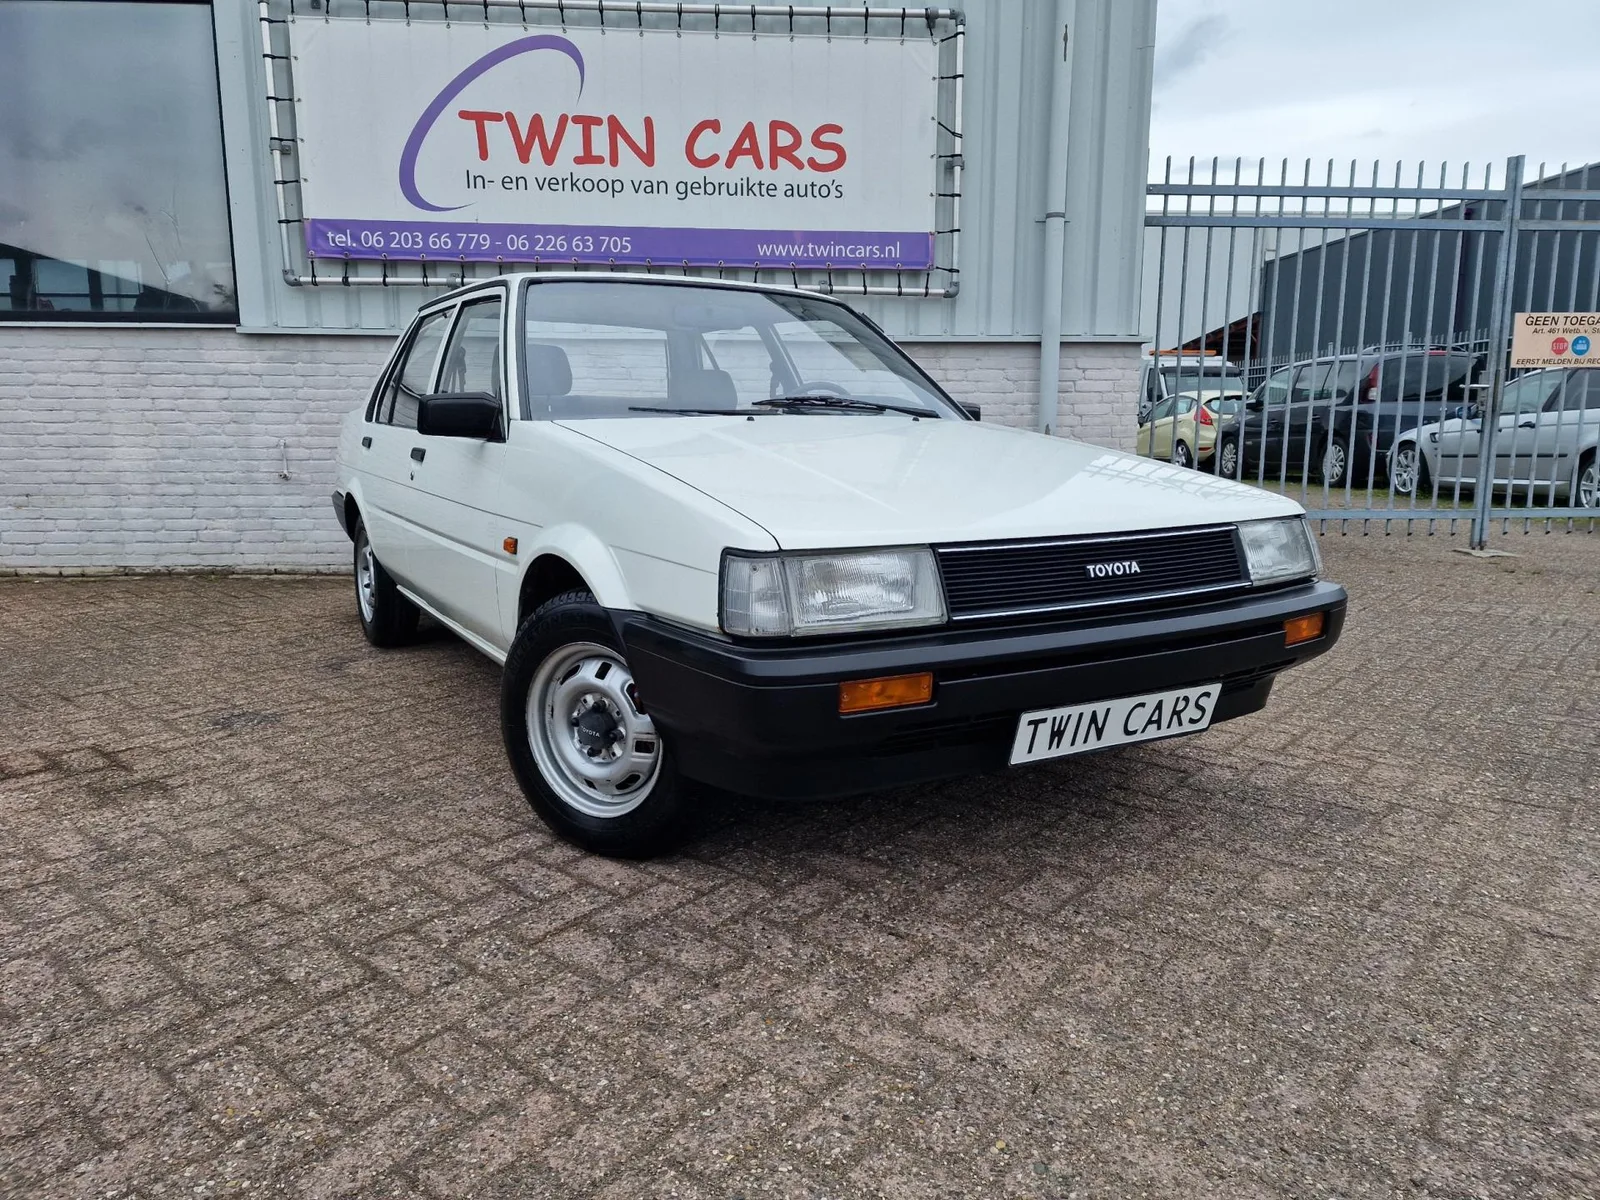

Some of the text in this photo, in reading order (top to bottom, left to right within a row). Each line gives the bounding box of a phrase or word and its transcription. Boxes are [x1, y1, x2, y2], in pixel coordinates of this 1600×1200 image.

[458, 109, 847, 173] TWIN CARS
[466, 170, 844, 200] In- en verkoop van gebruikte auto's
[327, 230, 357, 248] tel.
[361, 231, 384, 248] 06
[389, 231, 423, 249] 203
[428, 232, 452, 250] 66
[456, 233, 490, 250] 779
[506, 234, 529, 251] 06
[534, 235, 567, 252] 226
[572, 235, 594, 252] 63
[599, 236, 632, 253] 705
[757, 241, 900, 259] www.twincars.nl
[1525, 316, 1560, 326] GEEN
[1552, 342, 1568, 350] STOP
[1086, 561, 1141, 578] TOYOTA
[580, 725, 600, 738] TOYOTA
[1026, 692, 1211, 754] TWIN CARS
